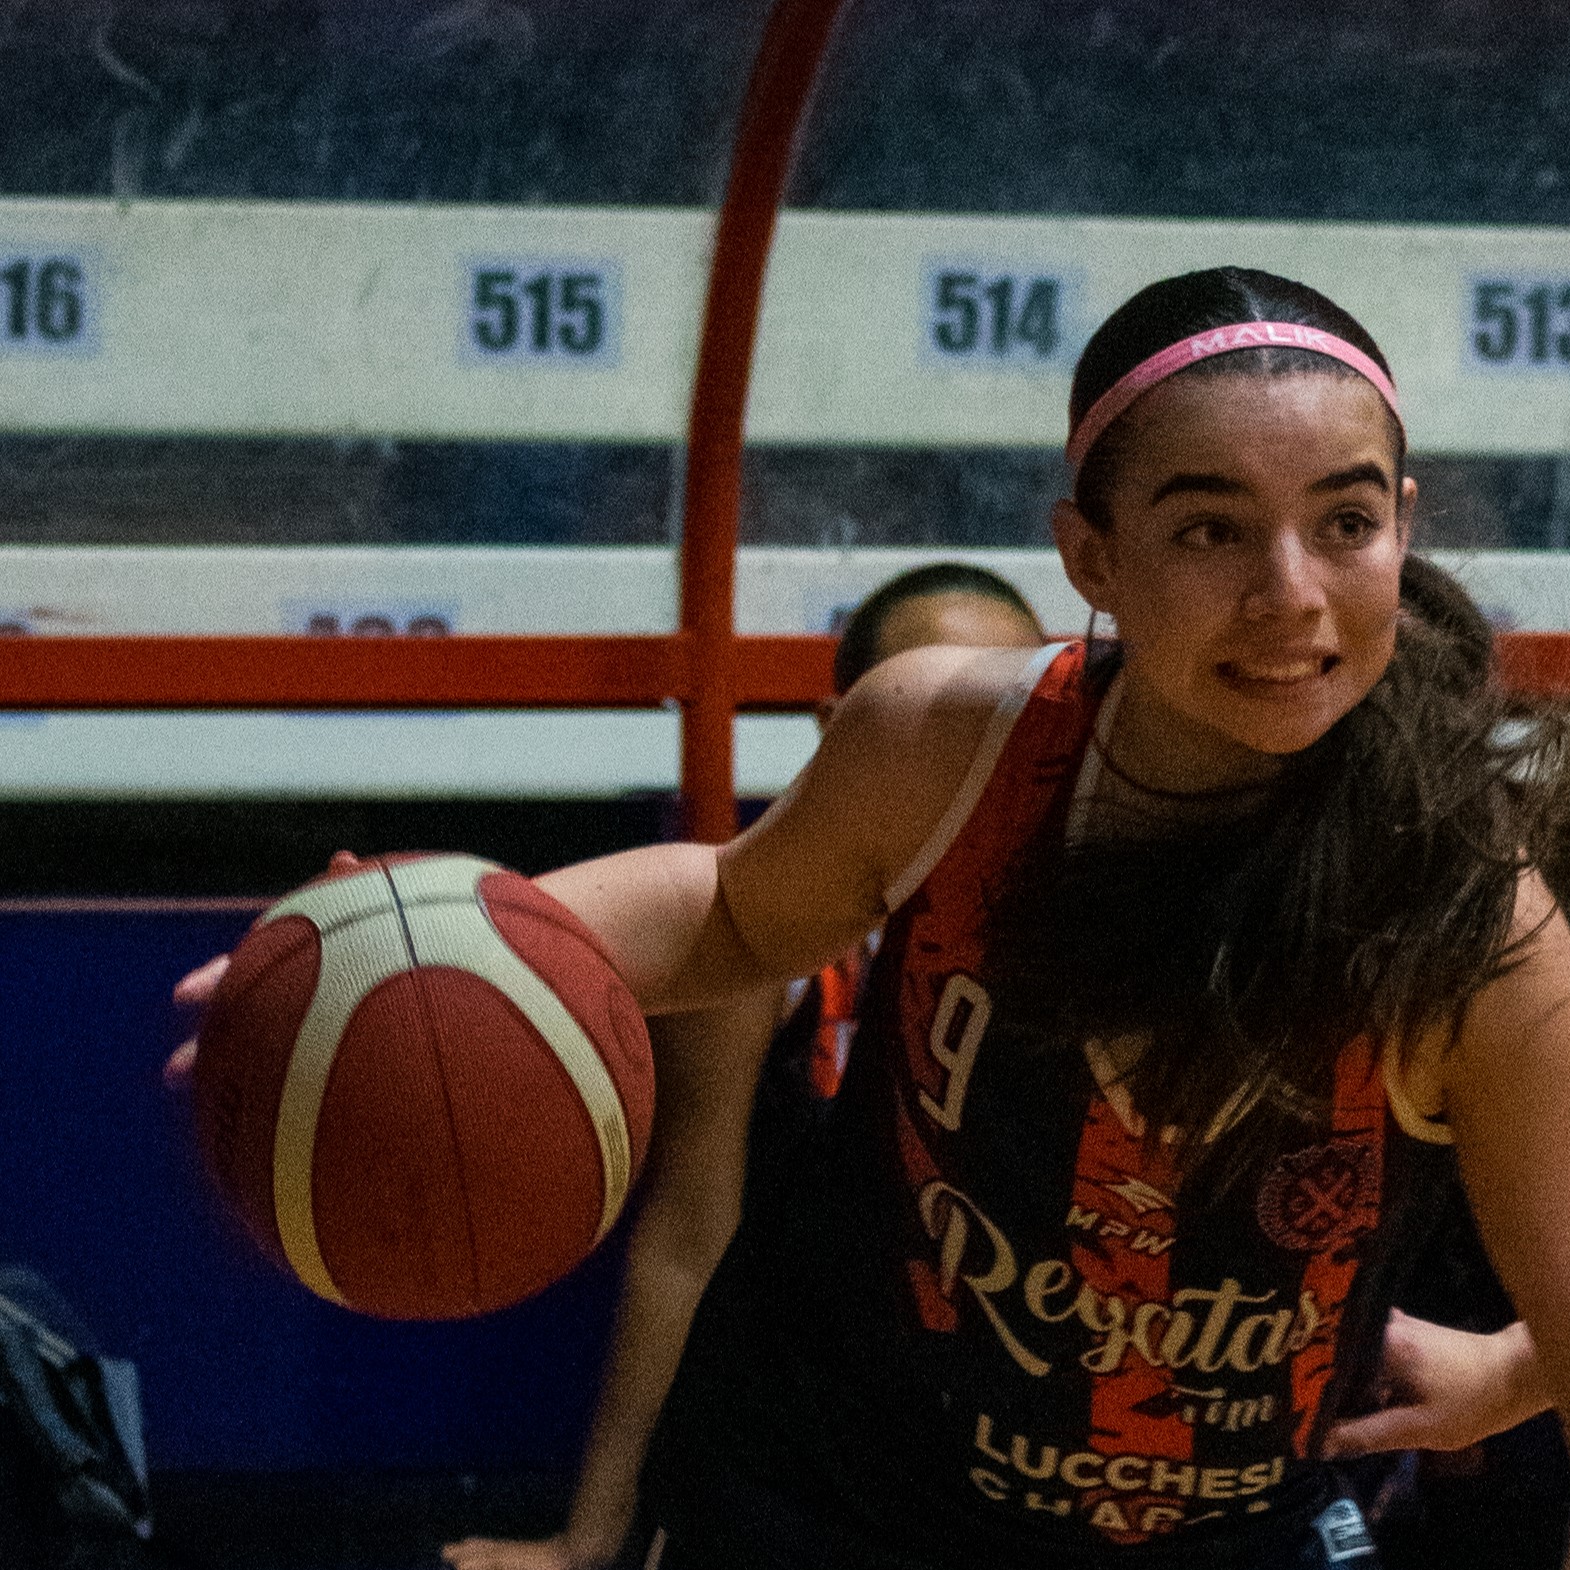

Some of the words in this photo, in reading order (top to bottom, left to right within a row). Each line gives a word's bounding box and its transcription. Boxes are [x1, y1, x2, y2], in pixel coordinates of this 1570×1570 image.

[474, 270, 603, 353] 515
[935, 273, 1059, 357] 514
[1190, 324, 1331, 357] MALIK
[918, 974, 992, 1132] 9
[1065, 1204, 1177, 1256] MPW
[918, 1181, 1321, 1378] Regatas
[974, 1413, 1285, 1499] LUCCHESI
